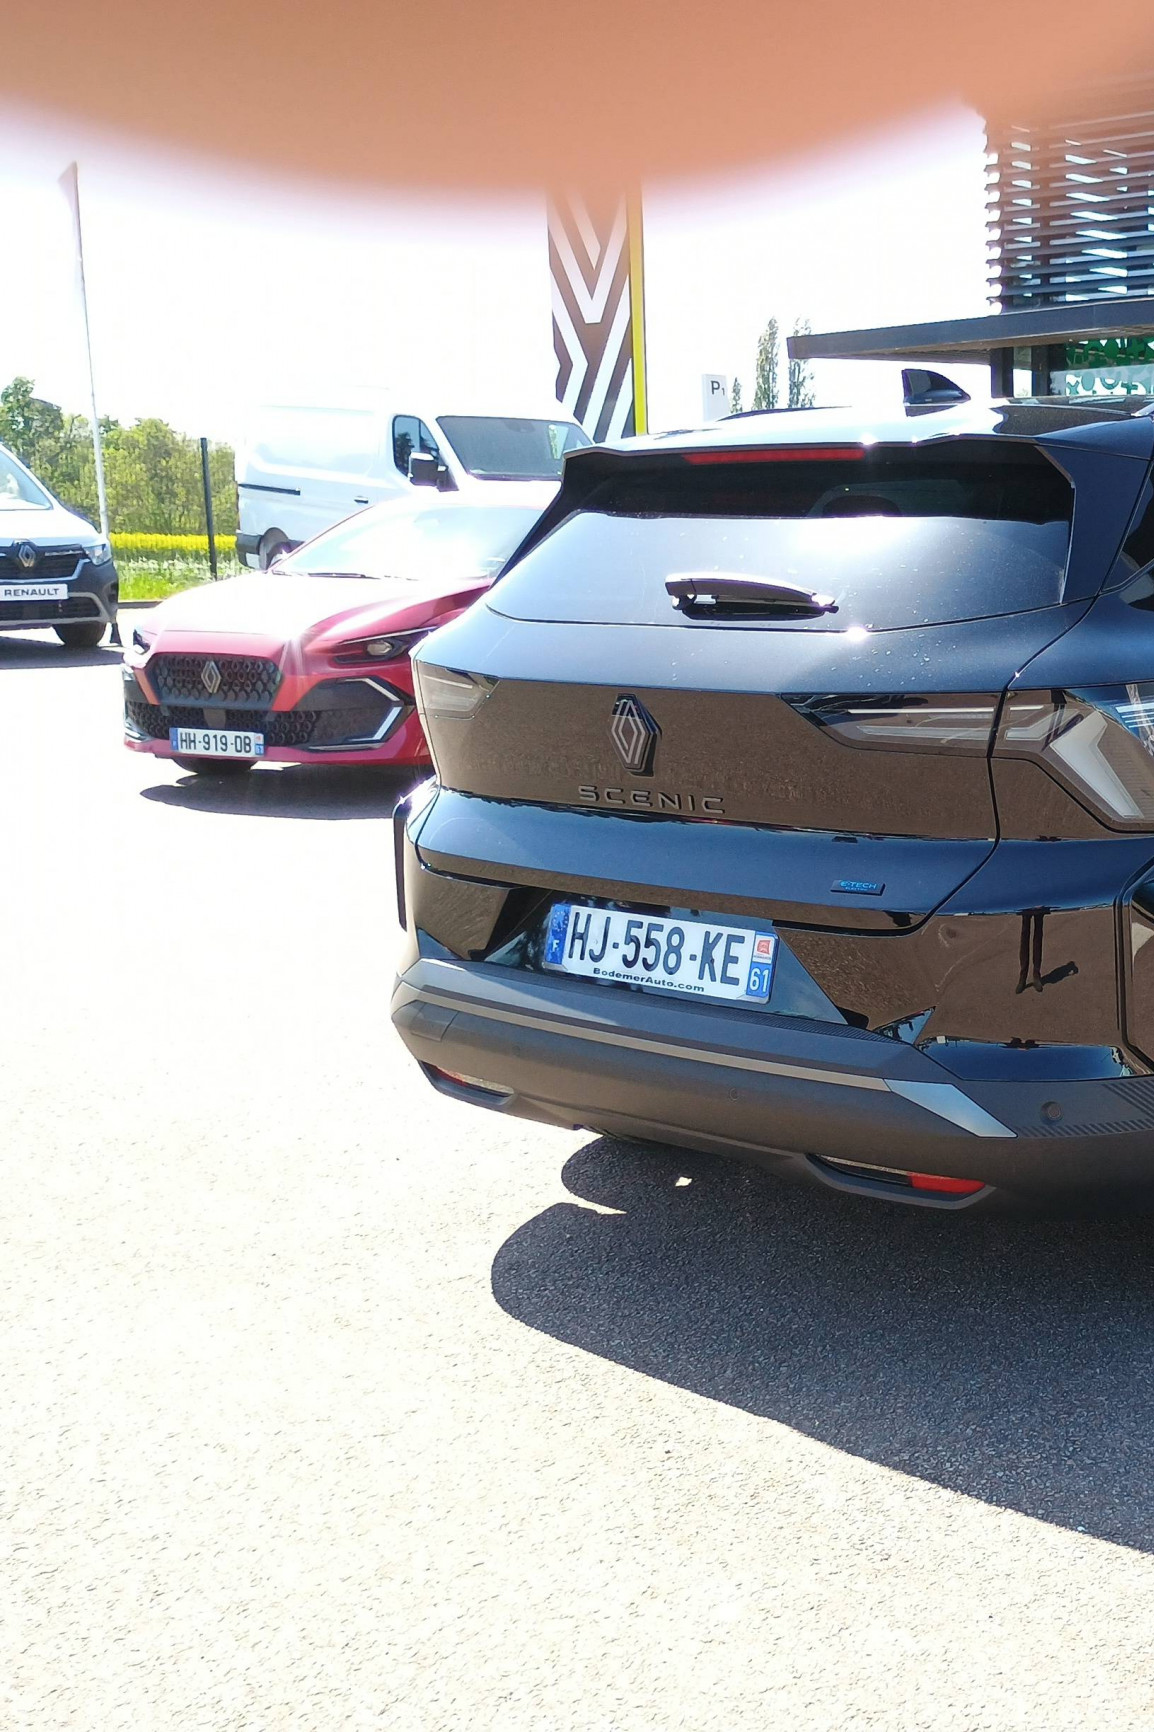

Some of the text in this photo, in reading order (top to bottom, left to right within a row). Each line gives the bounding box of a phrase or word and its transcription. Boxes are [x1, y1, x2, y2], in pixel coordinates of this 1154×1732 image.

[4, 588, 60, 597] RENAULT
[180, 732, 252, 753] HH-919-DB
[578, 785, 725, 814] SCENIC
[568, 911, 745, 986] HJ-558-KE
[592, 967, 705, 993] BodemerAuto.com
[749, 967, 770, 993] 61
